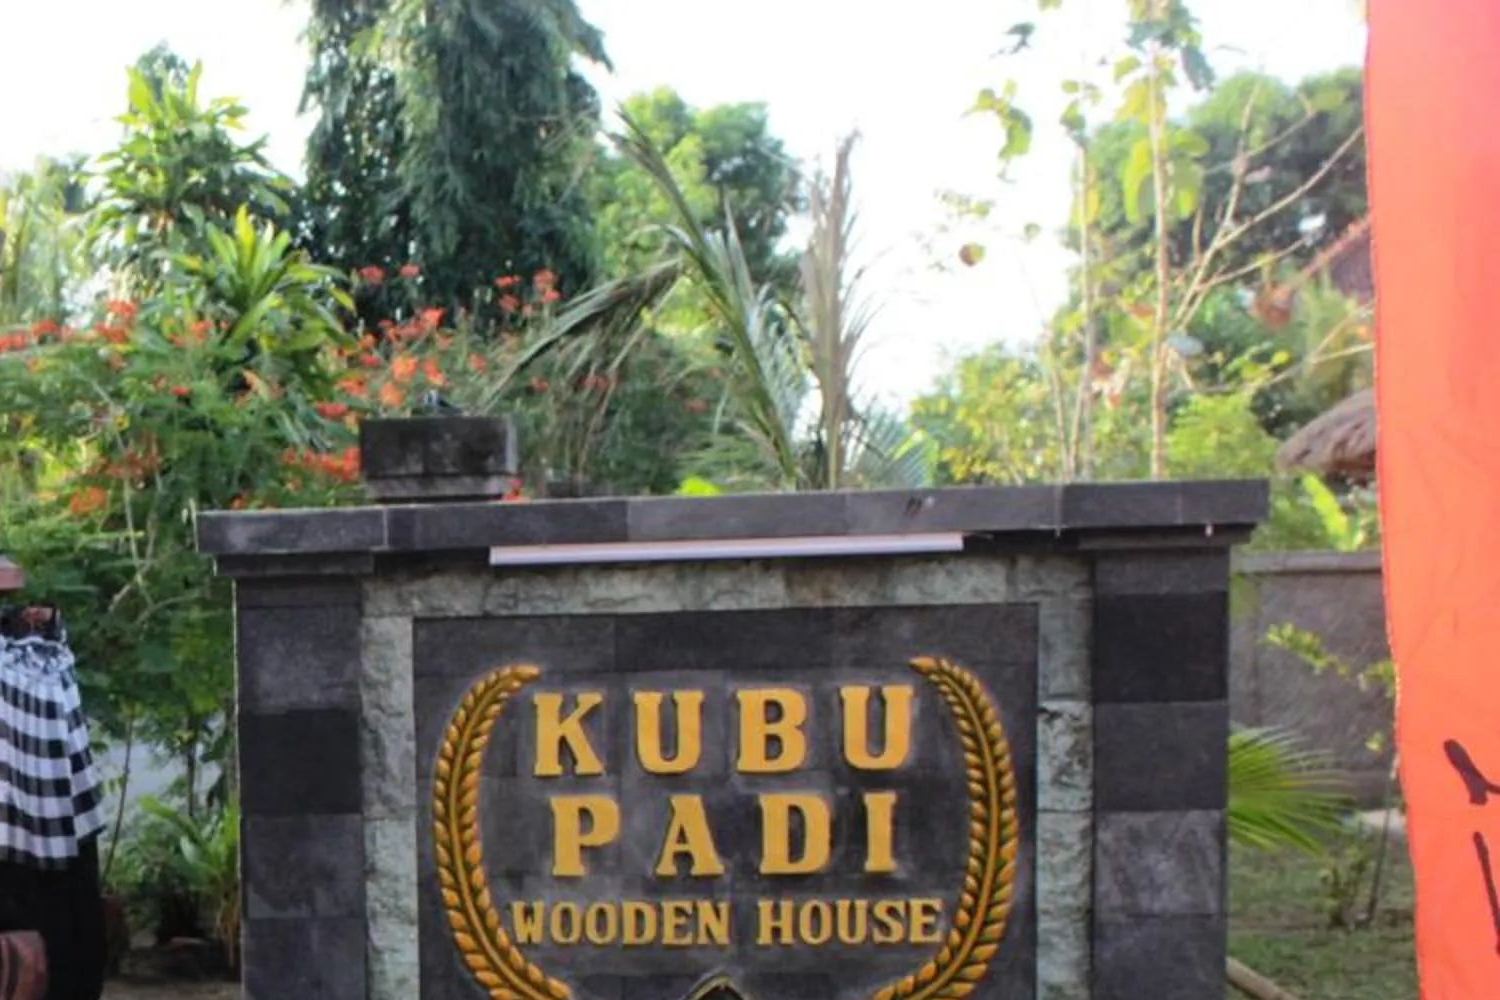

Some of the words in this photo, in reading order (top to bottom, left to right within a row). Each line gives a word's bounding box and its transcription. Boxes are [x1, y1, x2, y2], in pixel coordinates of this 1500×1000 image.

[533, 685, 914, 776] KUBU
[550, 792, 898, 877] PADI
[511, 899, 731, 945] WOODEN
[756, 897, 945, 945] HOUSE
